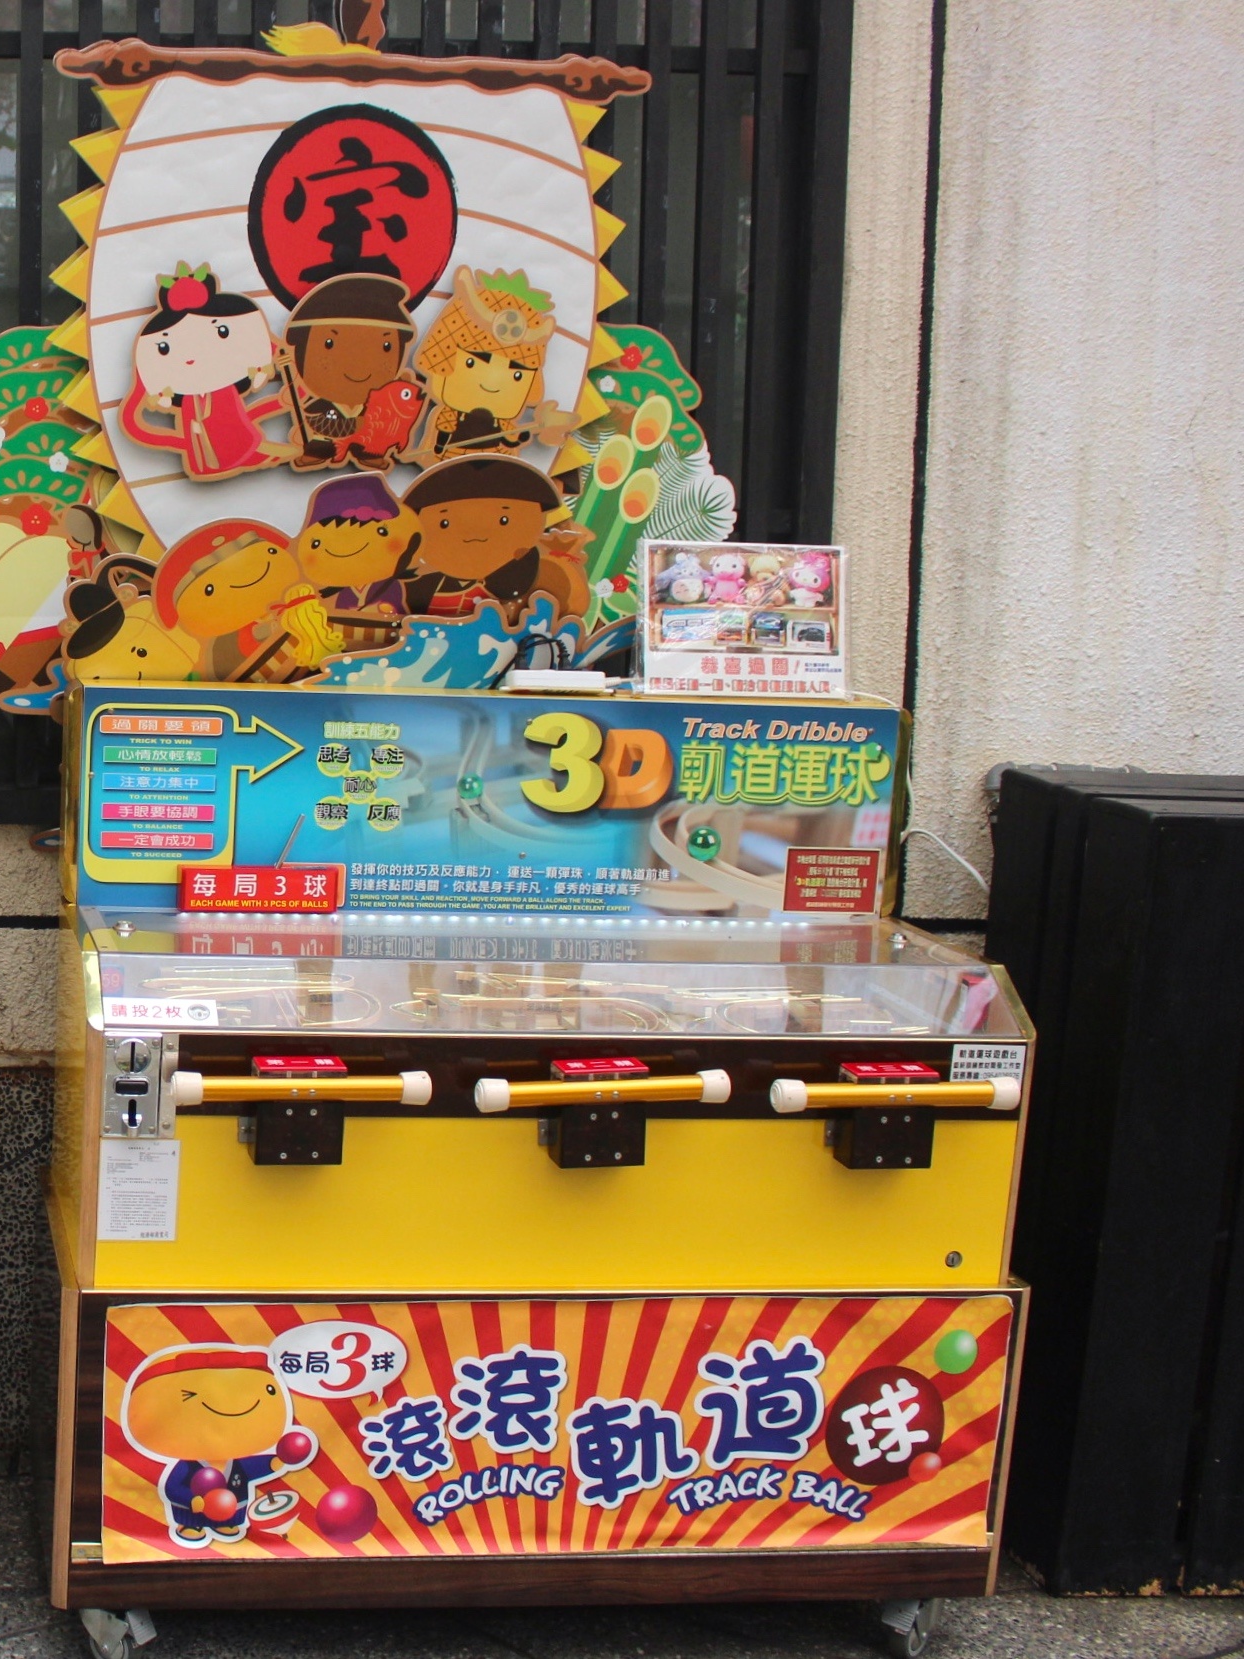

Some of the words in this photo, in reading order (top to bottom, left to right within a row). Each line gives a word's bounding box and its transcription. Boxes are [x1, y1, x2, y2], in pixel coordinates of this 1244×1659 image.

[283, 136, 430, 284] 宝
[112, 718, 211, 732] 過關要領
[324, 721, 401, 740] 訓練五能力
[682, 717, 760, 741] Track
[766, 719, 868, 743] Dribble
[118, 749, 202, 762] 心情放輕鬆
[318, 745, 350, 763] 思考
[372, 748, 404, 764] 專注
[520, 712, 674, 813] 3D
[119, 775, 199, 789] 注意力集中
[677, 741, 894, 806] 軌道運球
[344, 776, 377, 793] 耐心
[118, 805, 199, 819] 手眼要協調
[316, 803, 348, 820] 觀察
[367, 804, 401, 821] 反應
[118, 834, 196, 847] 一定會成功
[270, 900, 287, 908] PCS
[289, 900, 300, 908] OF
[301, 900, 328, 908] BALLS
[111, 1003, 183, 1019] 請投2枚
[279, 1331, 396, 1392] 每局3球
[417, 1466, 561, 1522] ROLLING
[669, 1467, 783, 1512] TRACK
[792, 1472, 873, 1520] BALL
